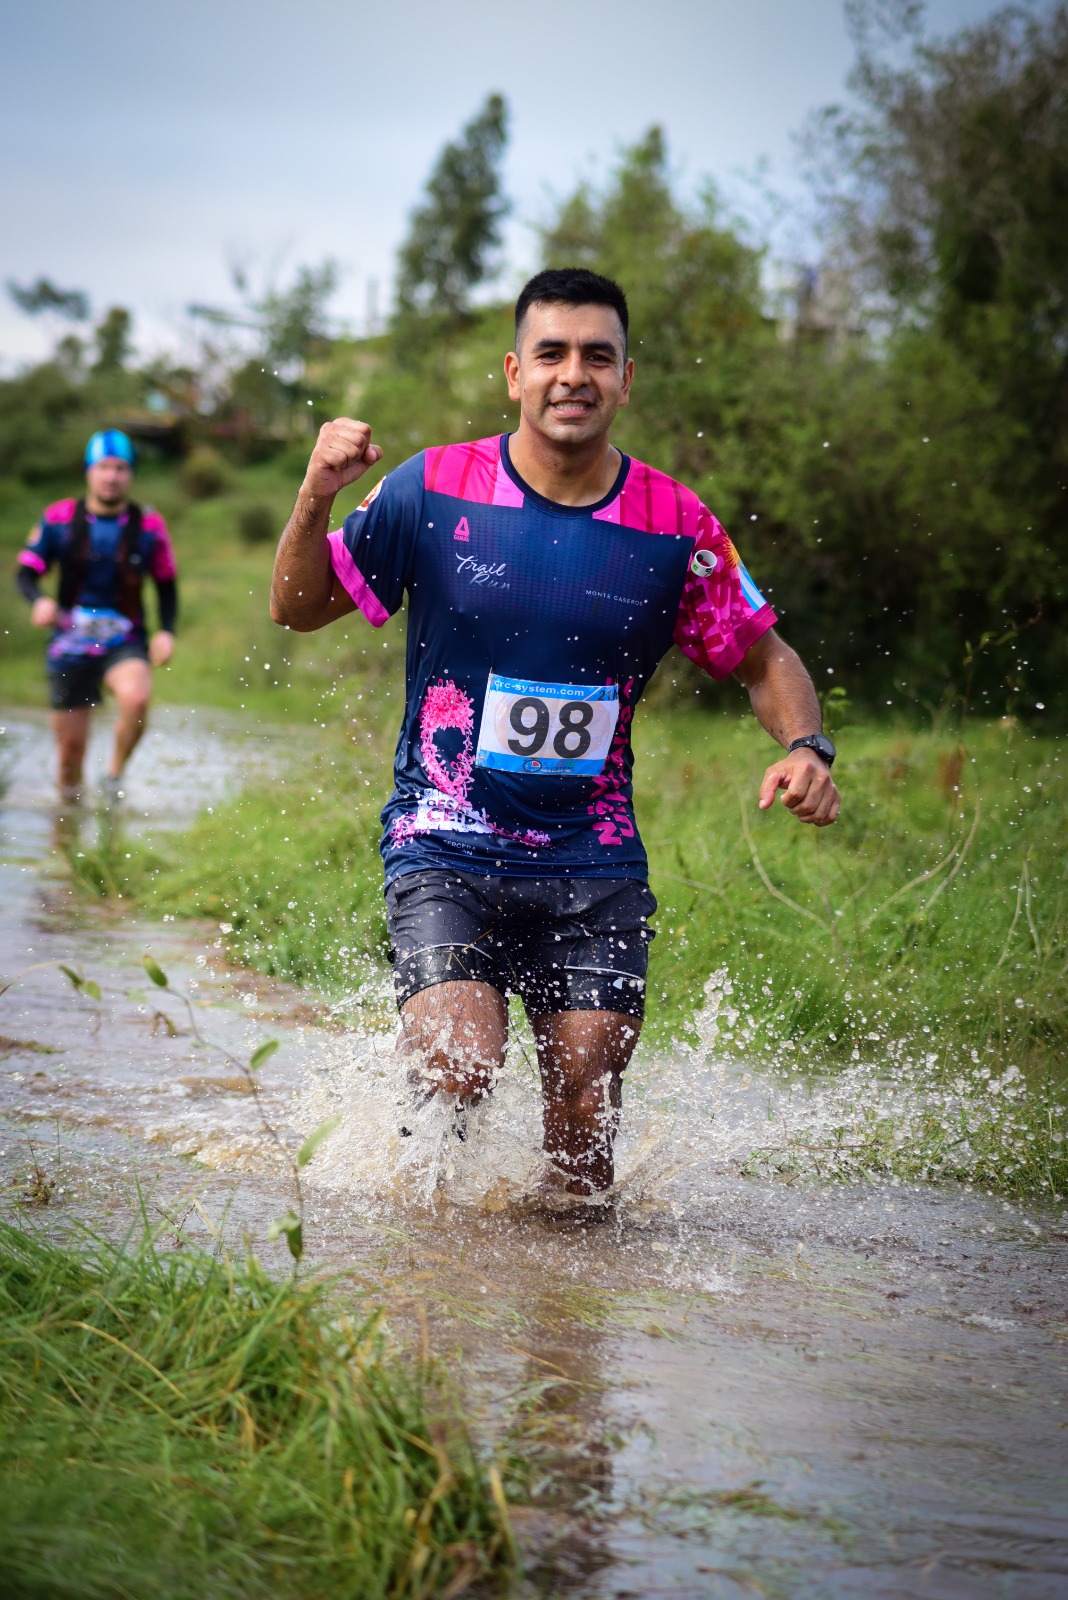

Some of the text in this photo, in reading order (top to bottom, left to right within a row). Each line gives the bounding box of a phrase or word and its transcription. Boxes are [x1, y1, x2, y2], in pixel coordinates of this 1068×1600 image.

[455, 552, 507, 576] Trail
[468, 571, 511, 590] Run
[585, 589, 643, 607] MONTE CASEROS
[507, 696, 594, 759] 98
